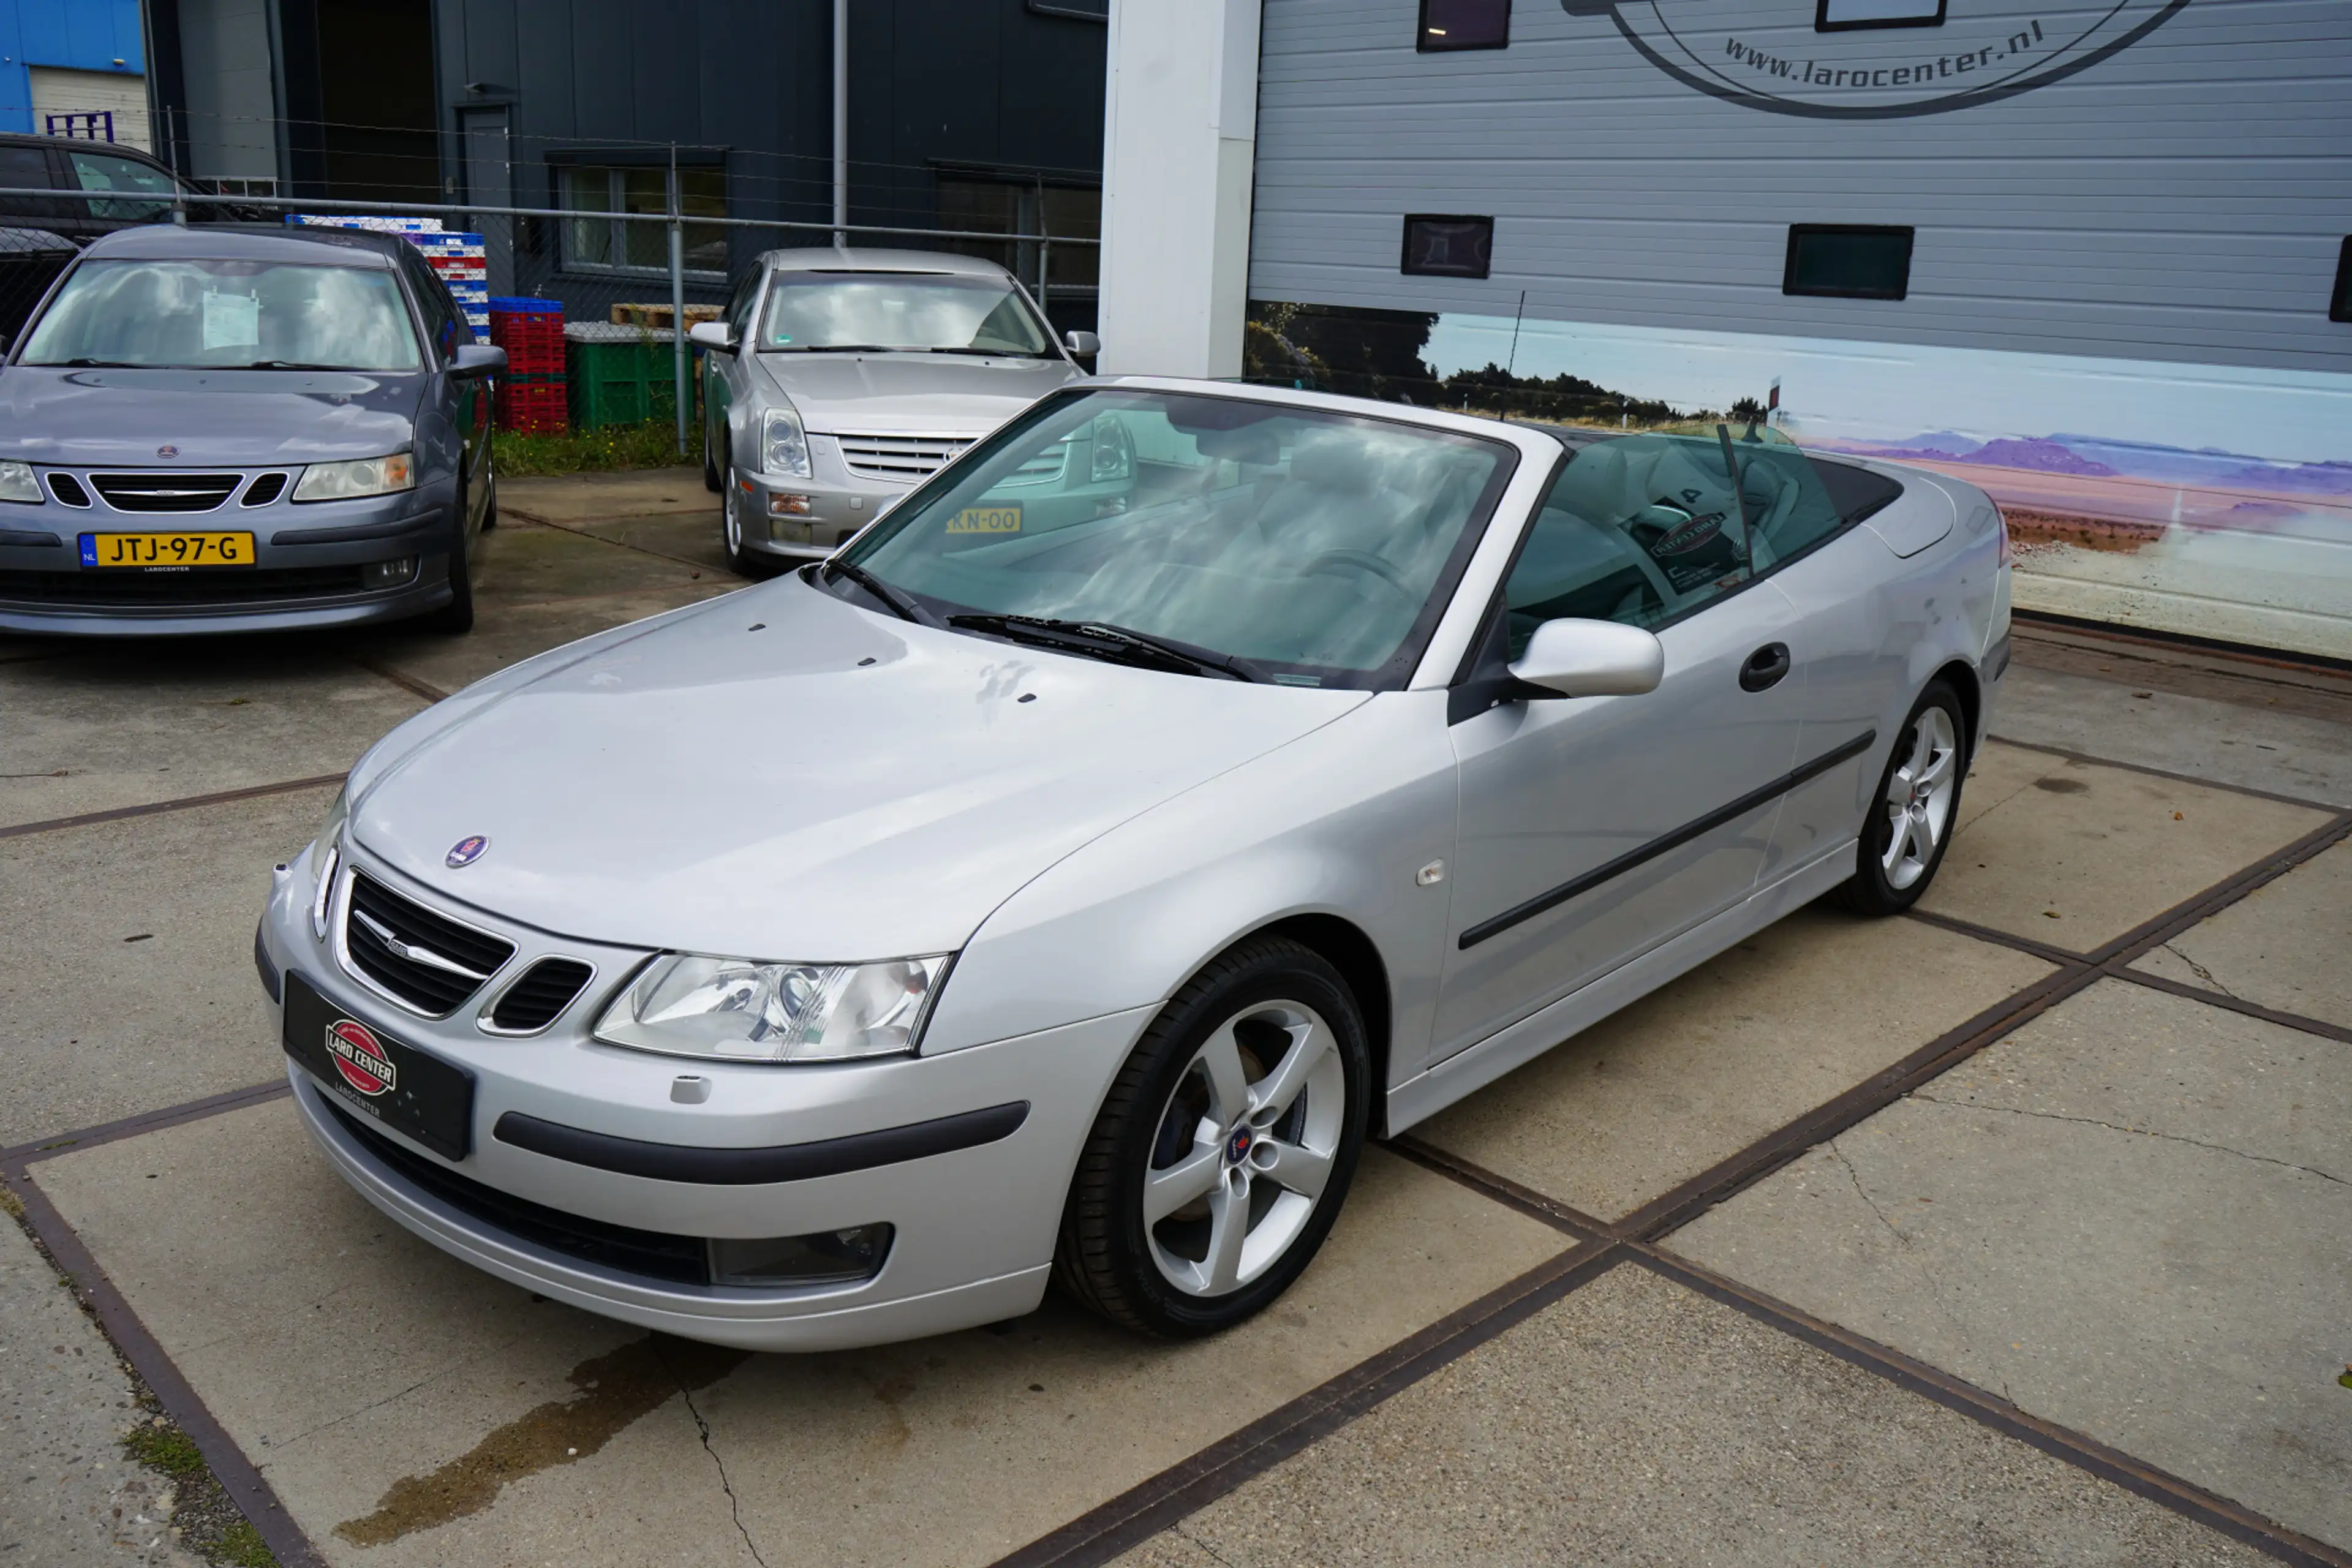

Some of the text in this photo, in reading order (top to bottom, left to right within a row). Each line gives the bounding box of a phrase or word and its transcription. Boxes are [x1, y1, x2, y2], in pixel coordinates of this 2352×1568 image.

[1725, 19, 2044, 88] www.larocenter.nl
[110, 537, 238, 561] JTJ-97-G
[329, 1033, 353, 1059] LARO
[355, 1050, 392, 1083] CENTER
[335, 1082, 380, 1118] LAROCENTER
